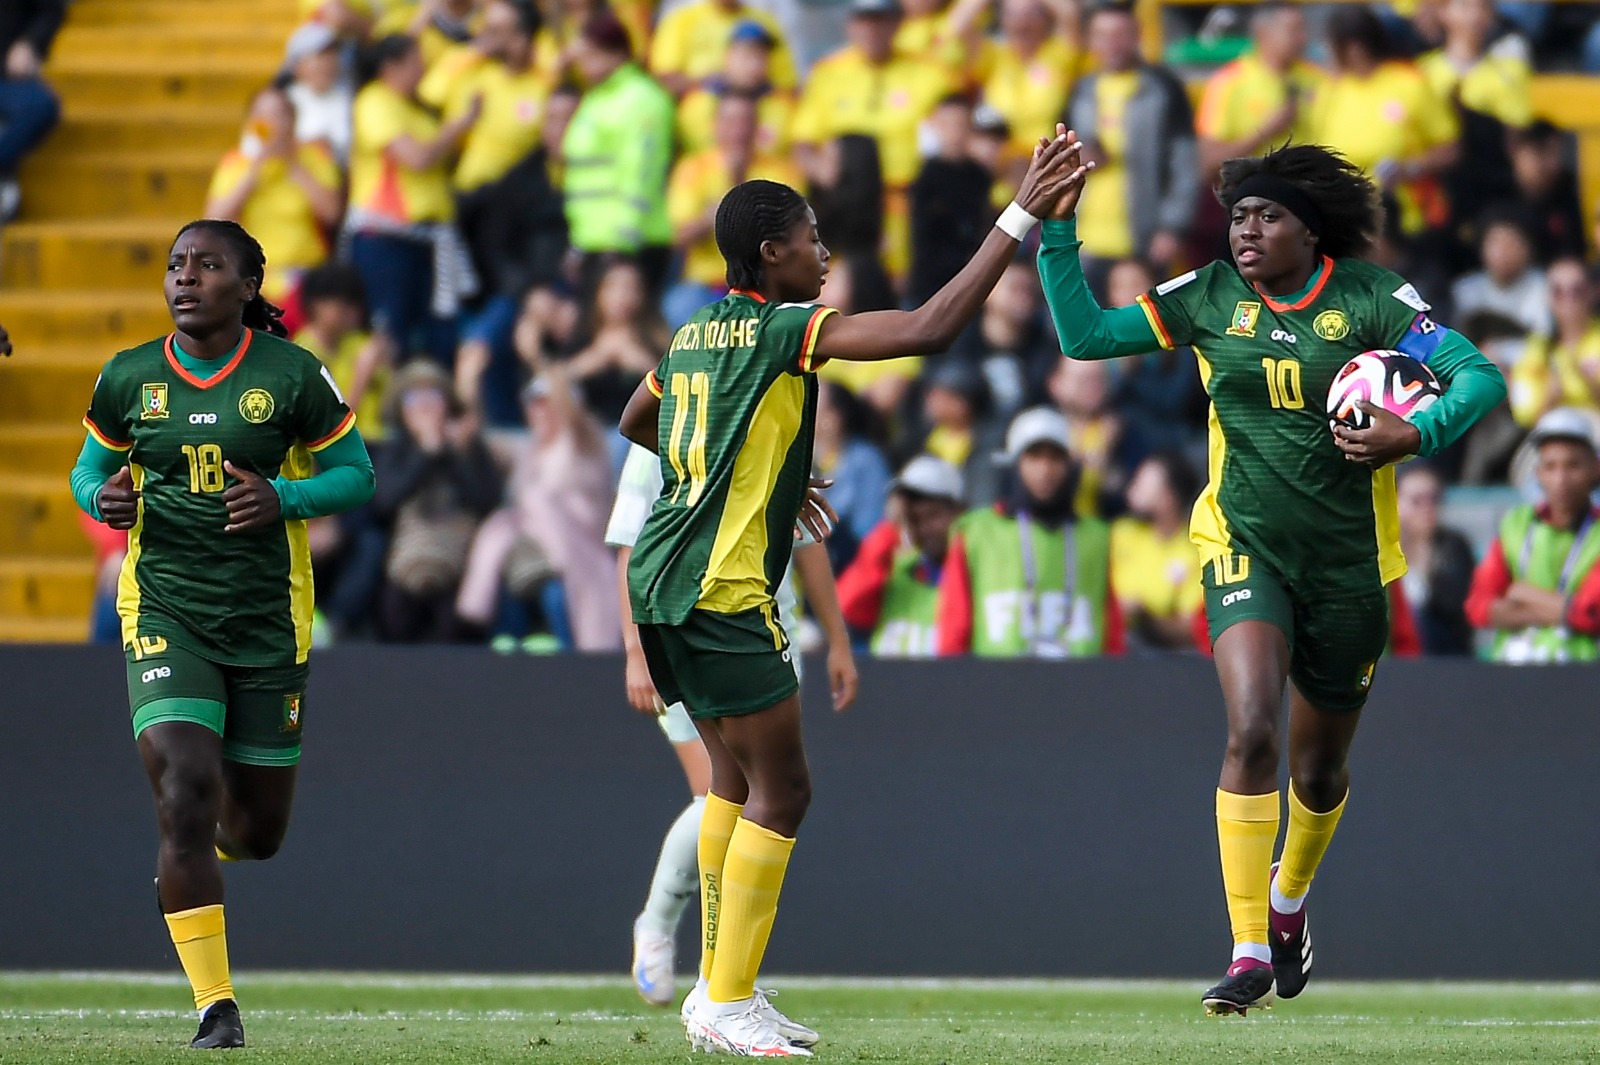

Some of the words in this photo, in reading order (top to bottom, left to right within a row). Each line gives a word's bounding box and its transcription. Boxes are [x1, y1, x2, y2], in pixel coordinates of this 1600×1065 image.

[1261, 357, 1304, 409] 10
[189, 413, 218, 424] one
[669, 372, 710, 507] 11
[181, 444, 225, 493] 18
[985, 590, 1093, 642] FIFA
[1222, 589, 1252, 606] one
[142, 666, 172, 683] one
[705, 873, 719, 950] CAMEROUN
